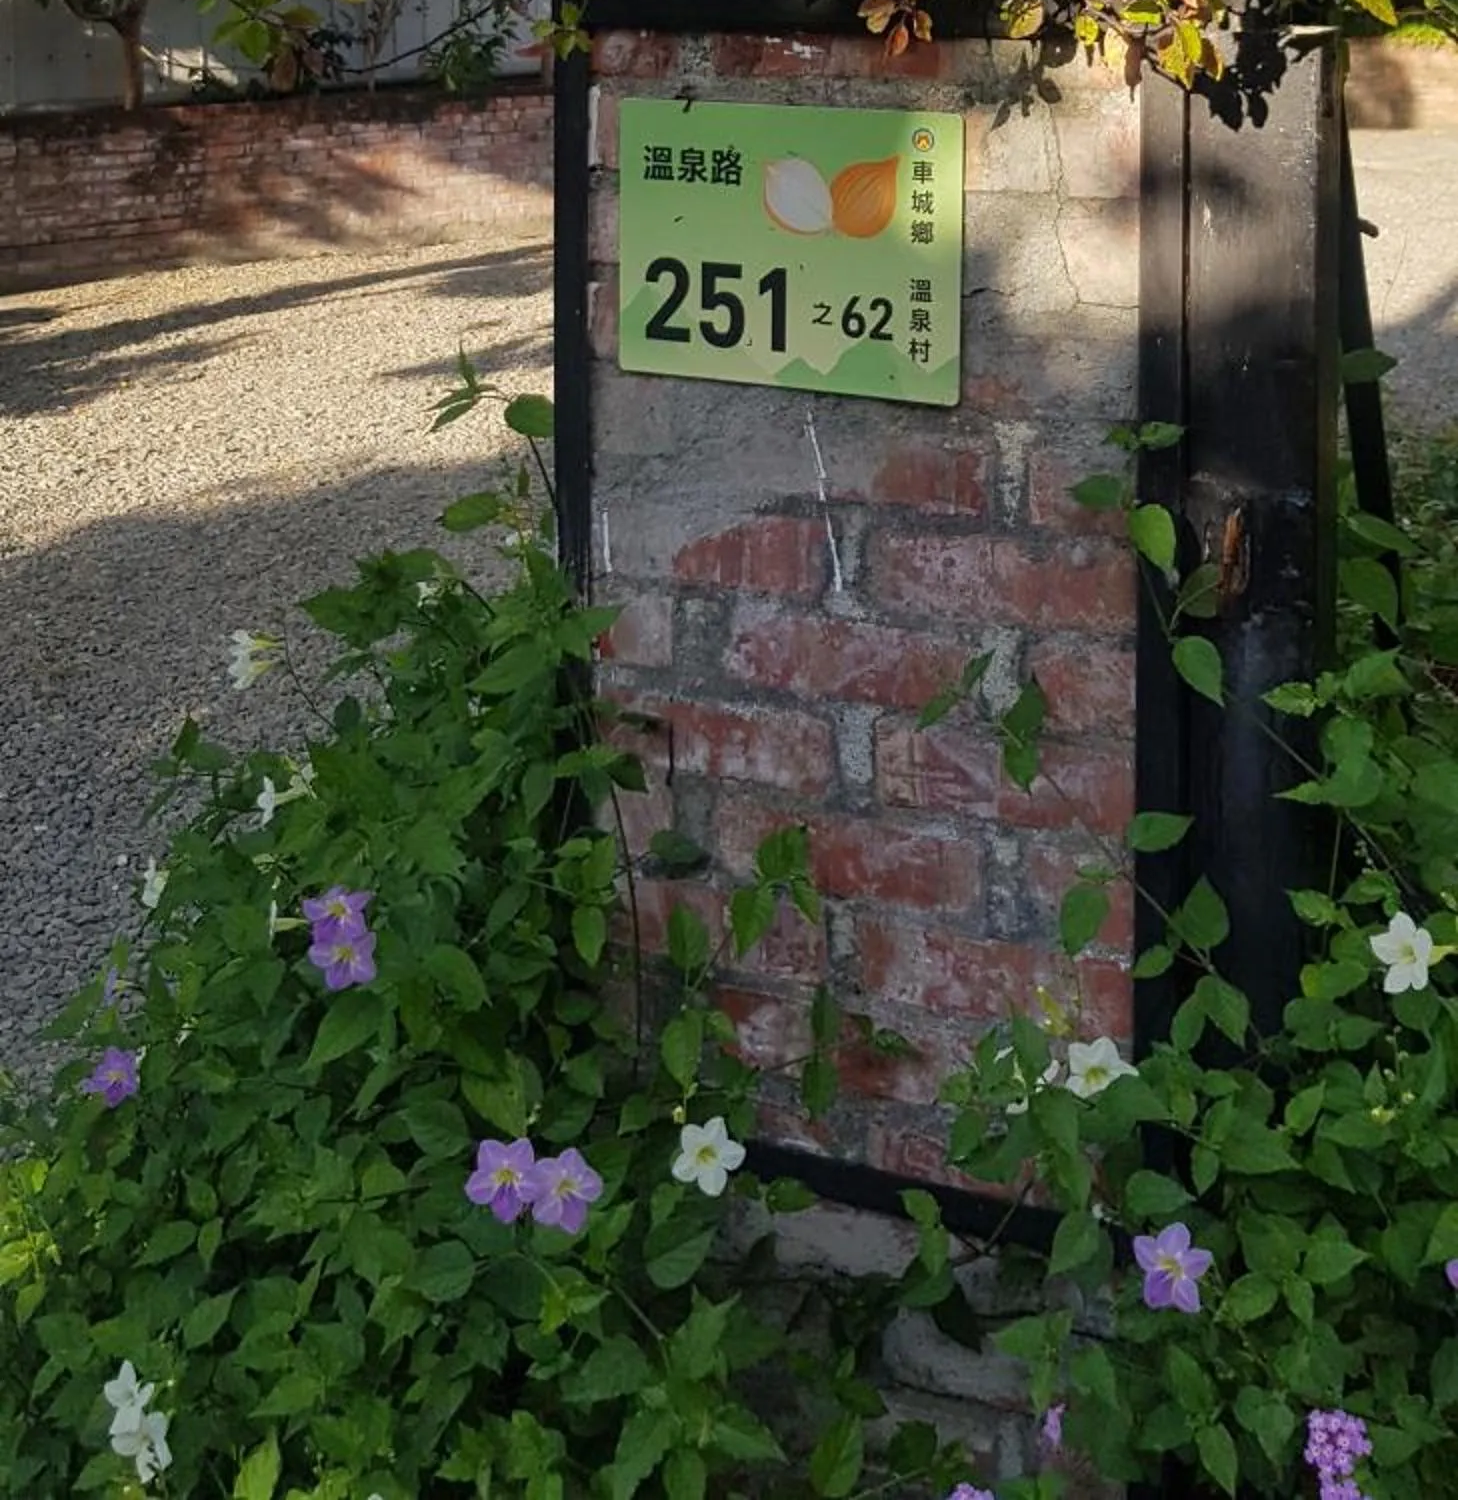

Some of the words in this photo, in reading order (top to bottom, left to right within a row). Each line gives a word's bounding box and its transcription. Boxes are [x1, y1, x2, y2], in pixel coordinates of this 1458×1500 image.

[643, 145, 743, 186] 溫泉路
[911, 160, 935, 245] 車城鄉
[908, 278, 932, 364] 溫泉村
